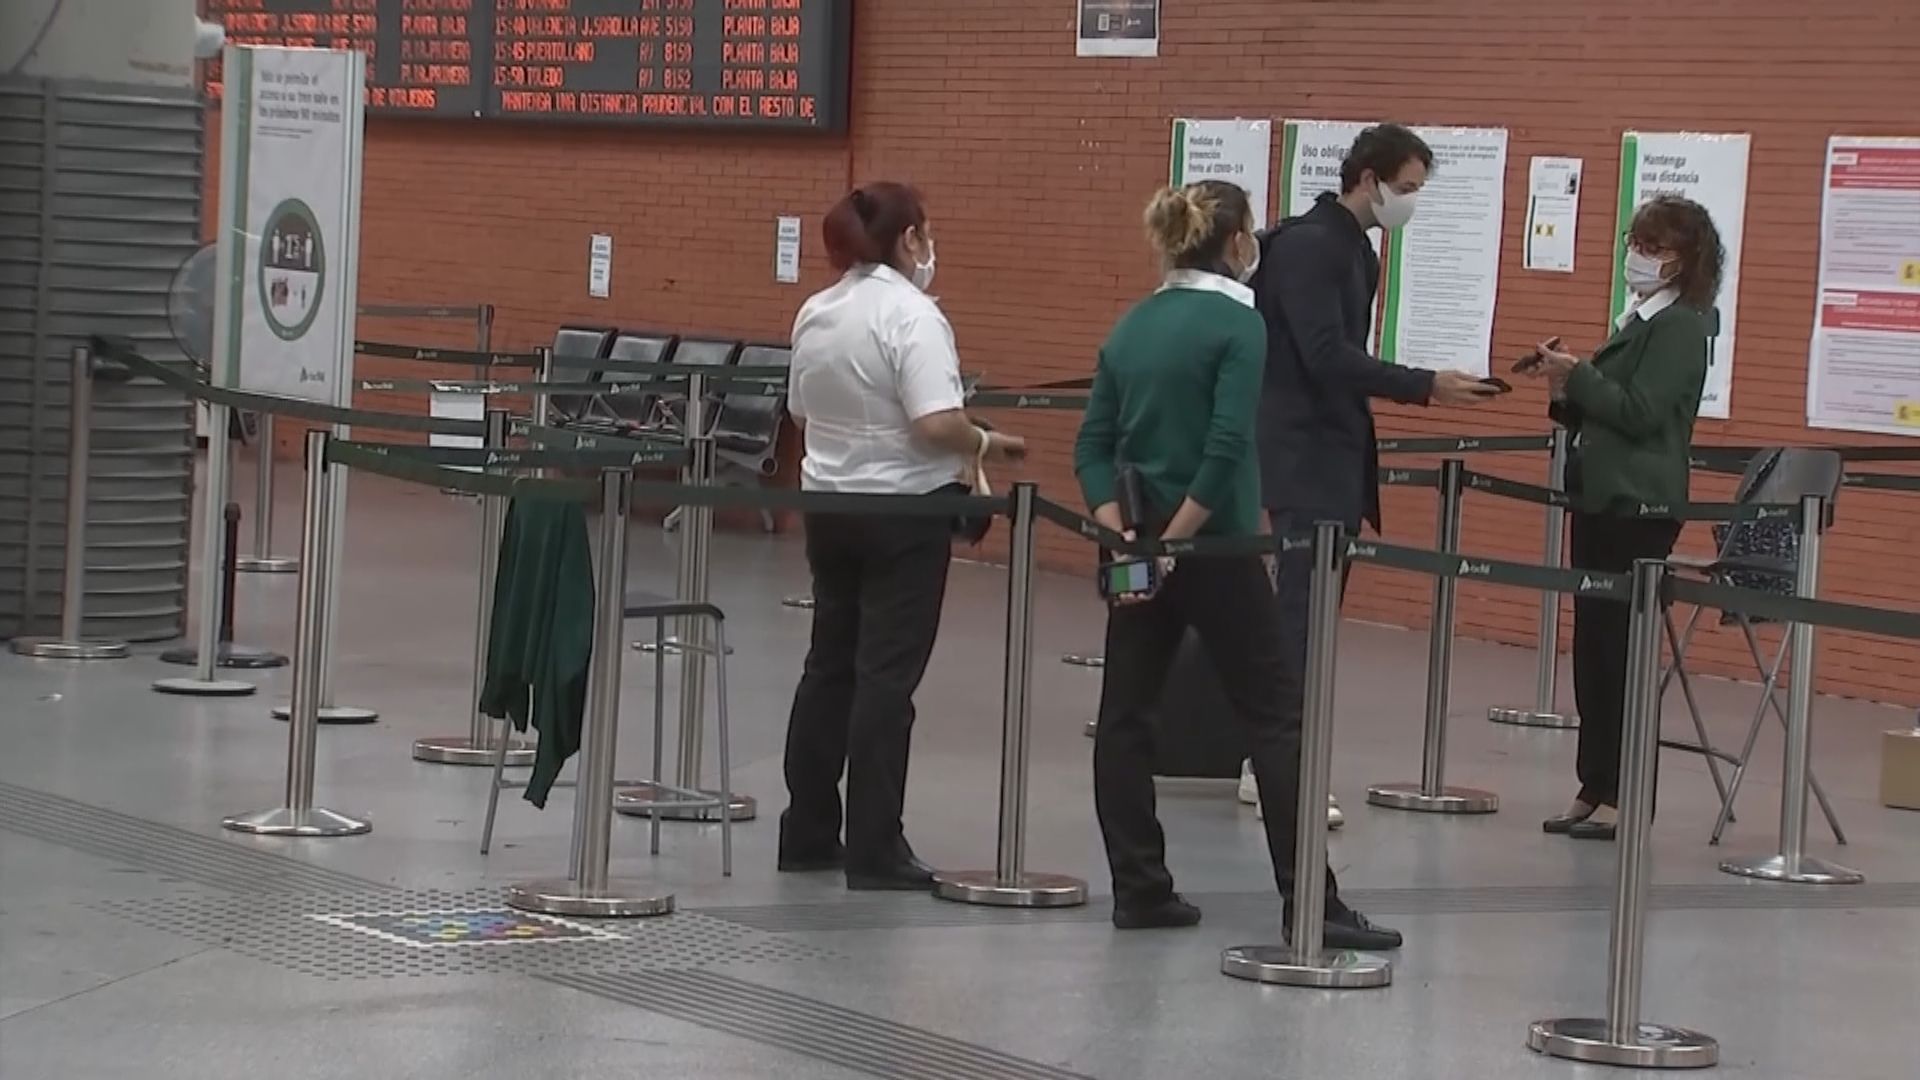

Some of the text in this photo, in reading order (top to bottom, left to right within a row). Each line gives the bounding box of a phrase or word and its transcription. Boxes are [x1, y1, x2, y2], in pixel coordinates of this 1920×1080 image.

[402, 16, 438, 34] PLANTA
[527, 16, 577, 35] VALENCIA
[582, 16, 638, 36] J.SOROLLA
[723, 16, 765, 36] PLANTA
[771, 16, 800, 36] BAJA
[527, 42, 594, 61] PUERTOLLANO
[723, 43, 765, 63] PLANTA
[770, 43, 798, 63] BAJA
[527, 66, 563, 87] TOLEDO
[664, 69, 691, 88] 8152
[722, 69, 764, 89] PLANTA
[769, 70, 798, 89] BAJA
[502, 91, 815, 117] MANTENGA UNA DISTANCIA PRUDENCIAL CON EL RESTO DE
[1189, 136, 1213, 146] Medidas
[1302, 144, 1352, 161] Uso obliga
[1301, 163, 1313, 176] de
[1643, 154, 1686, 169] Mantenga
[1641, 170, 1699, 183] una distancia
